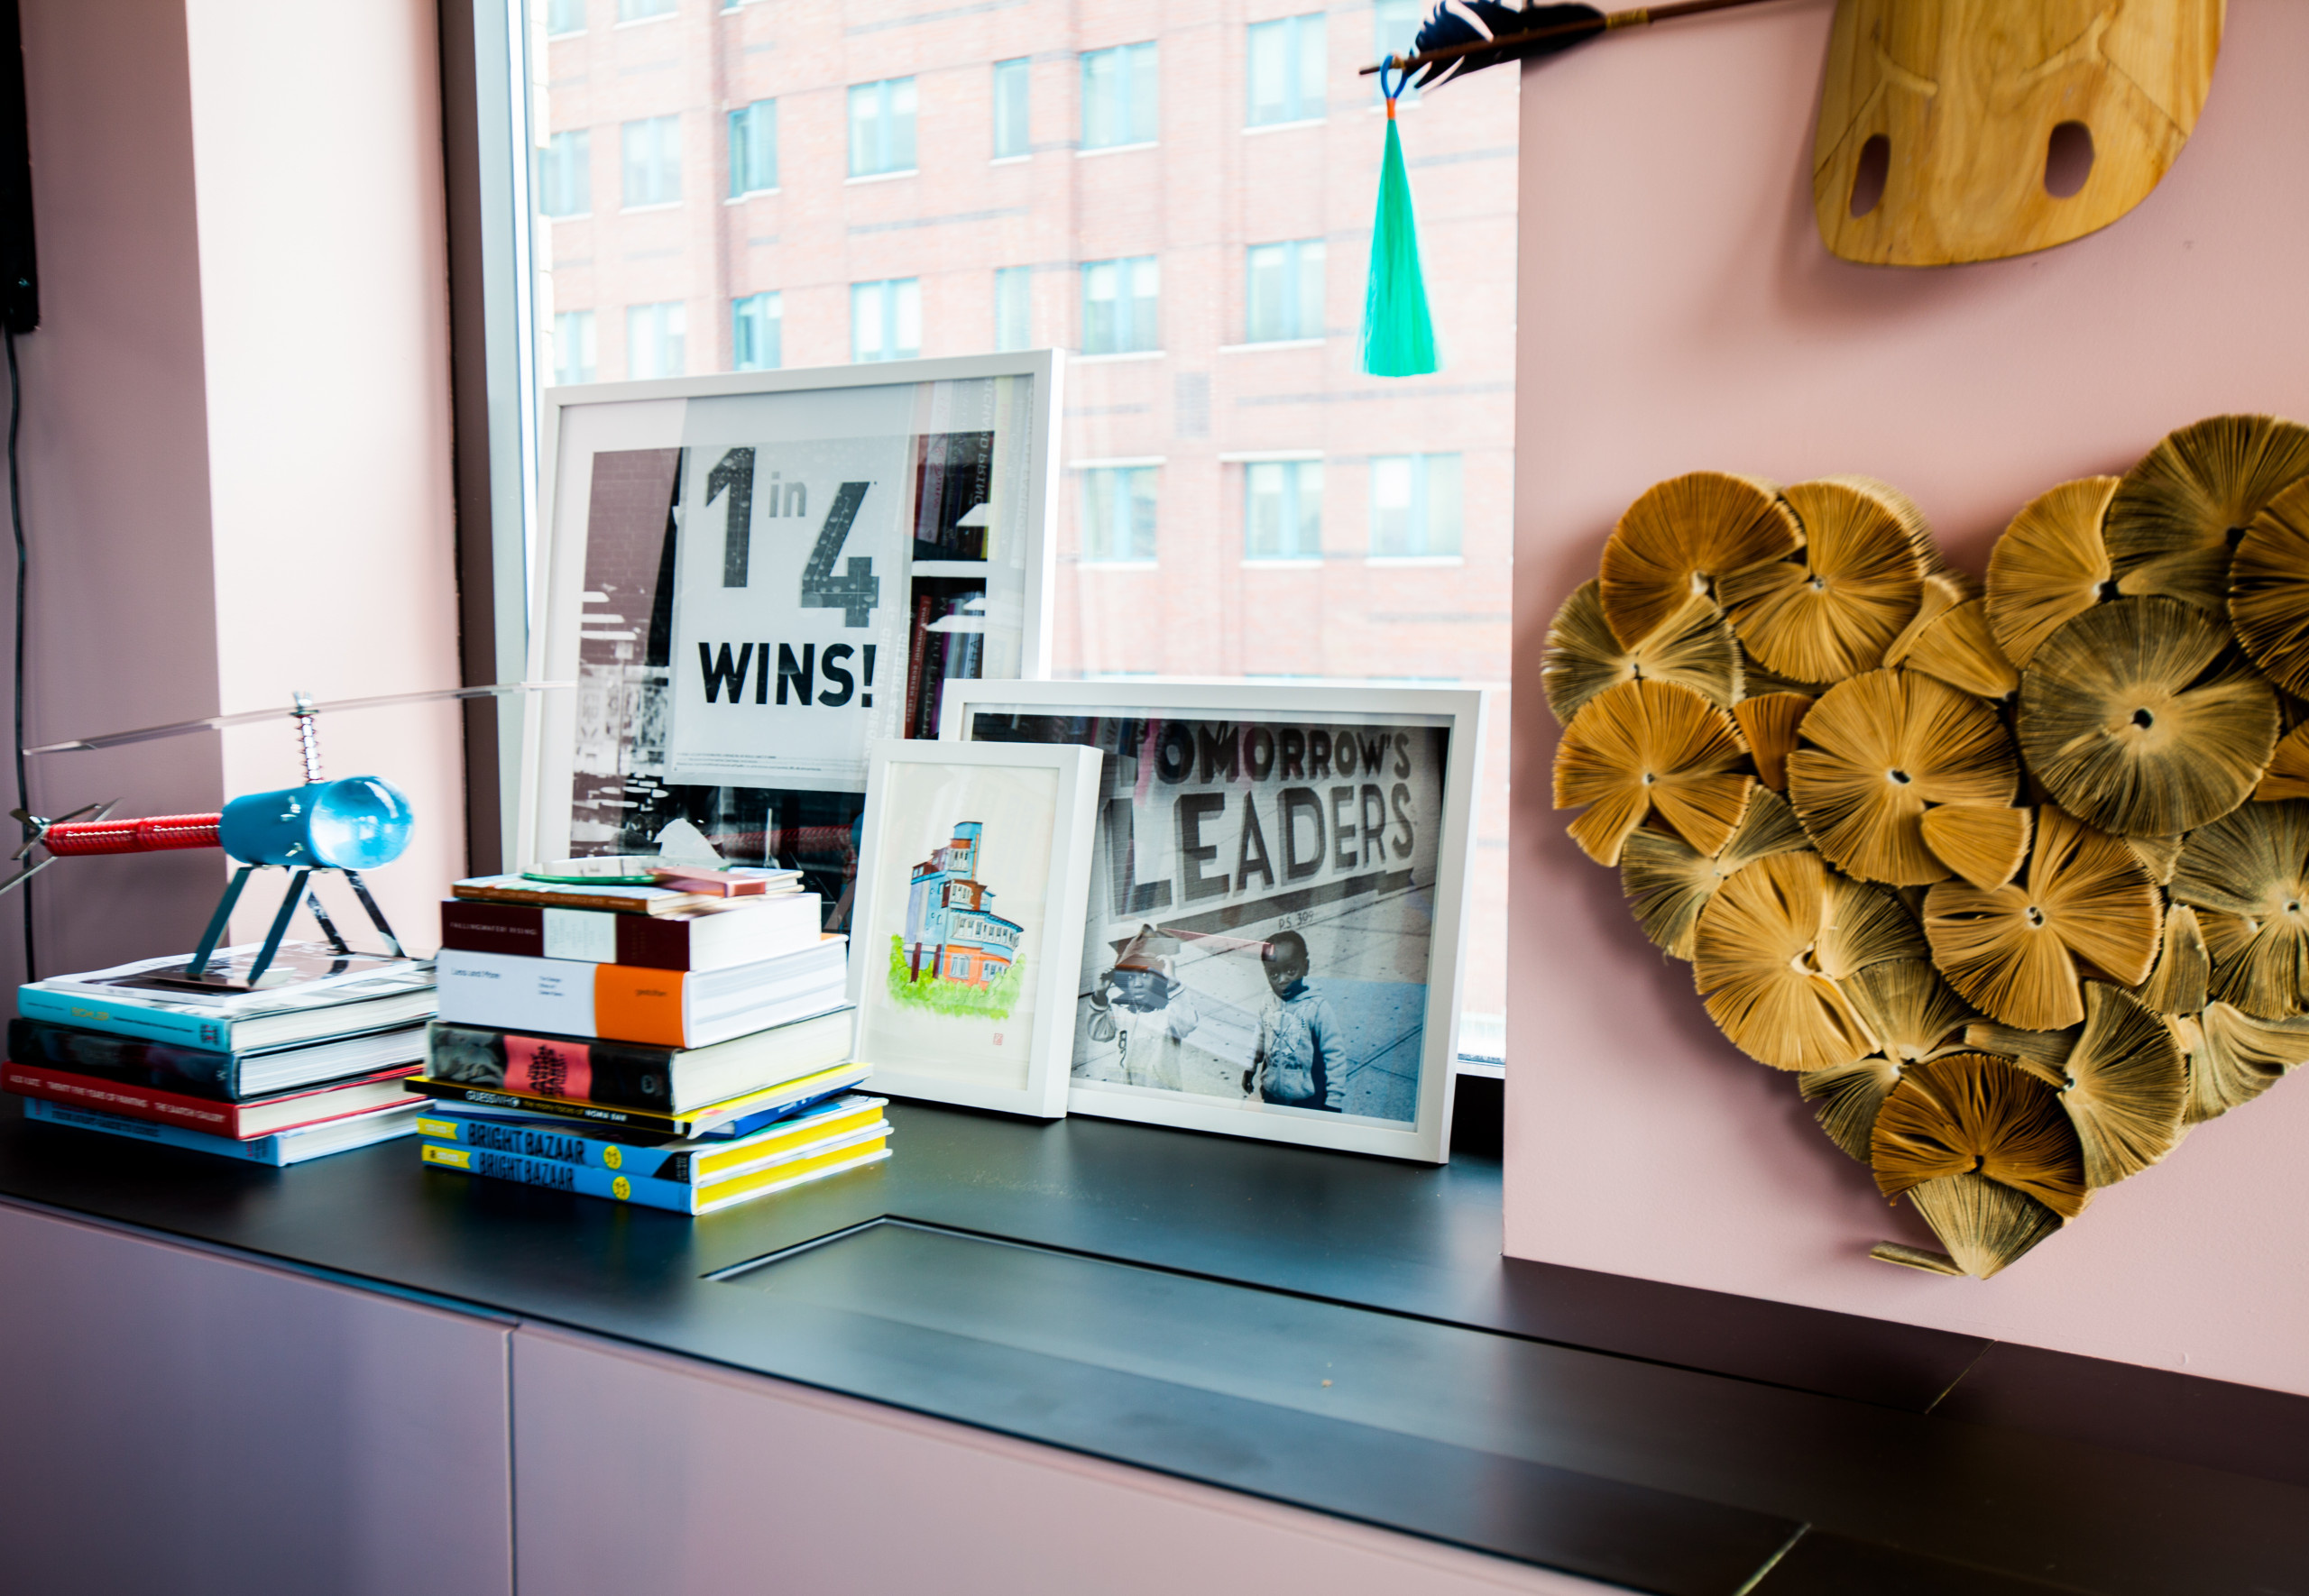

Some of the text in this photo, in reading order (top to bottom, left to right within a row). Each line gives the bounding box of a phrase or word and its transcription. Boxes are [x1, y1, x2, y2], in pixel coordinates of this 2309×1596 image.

[705, 447, 880, 628] 1 in 4
[698, 642, 877, 708] WINS!
[1102, 783, 1414, 923] LEADERS
[468, 1123, 523, 1154] BRIGHT
[524, 1132, 586, 1166] BAZAAR
[479, 1151, 523, 1183] BRIGHT
[525, 1160, 575, 1191] BAZAAR
